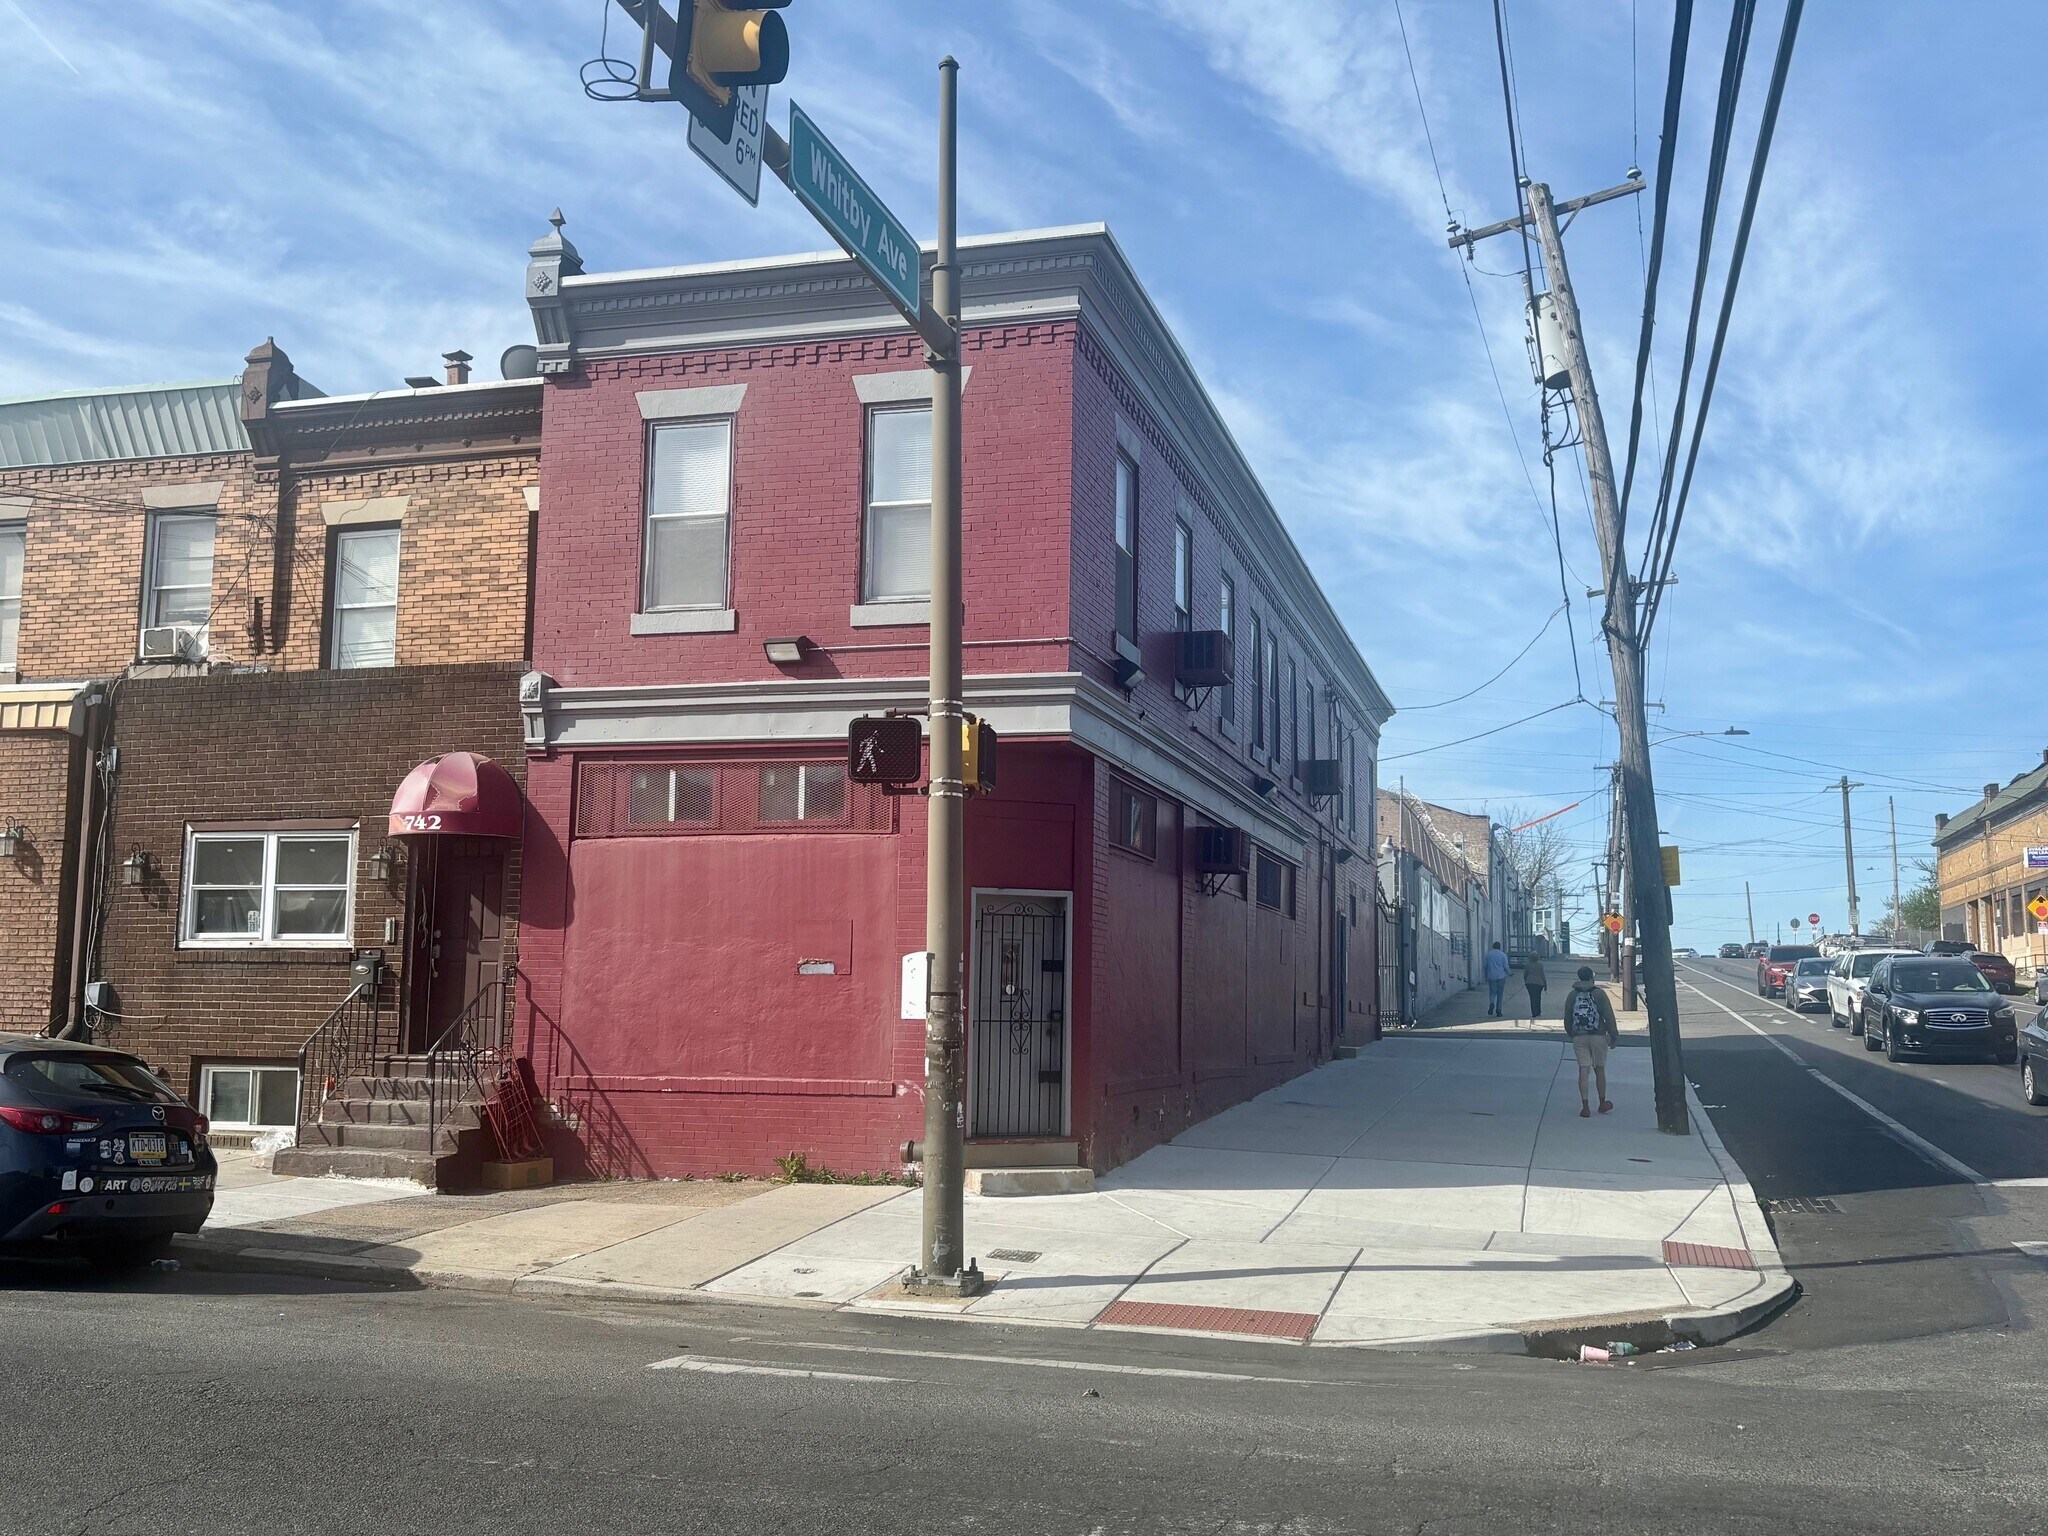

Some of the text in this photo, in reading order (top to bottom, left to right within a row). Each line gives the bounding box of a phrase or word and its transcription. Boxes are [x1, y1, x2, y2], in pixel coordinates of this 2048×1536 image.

[810, 141, 907, 281] Whitby Ave
[404, 814, 442, 830] 742
[131, 1138, 165, 1152] KTD-0318
